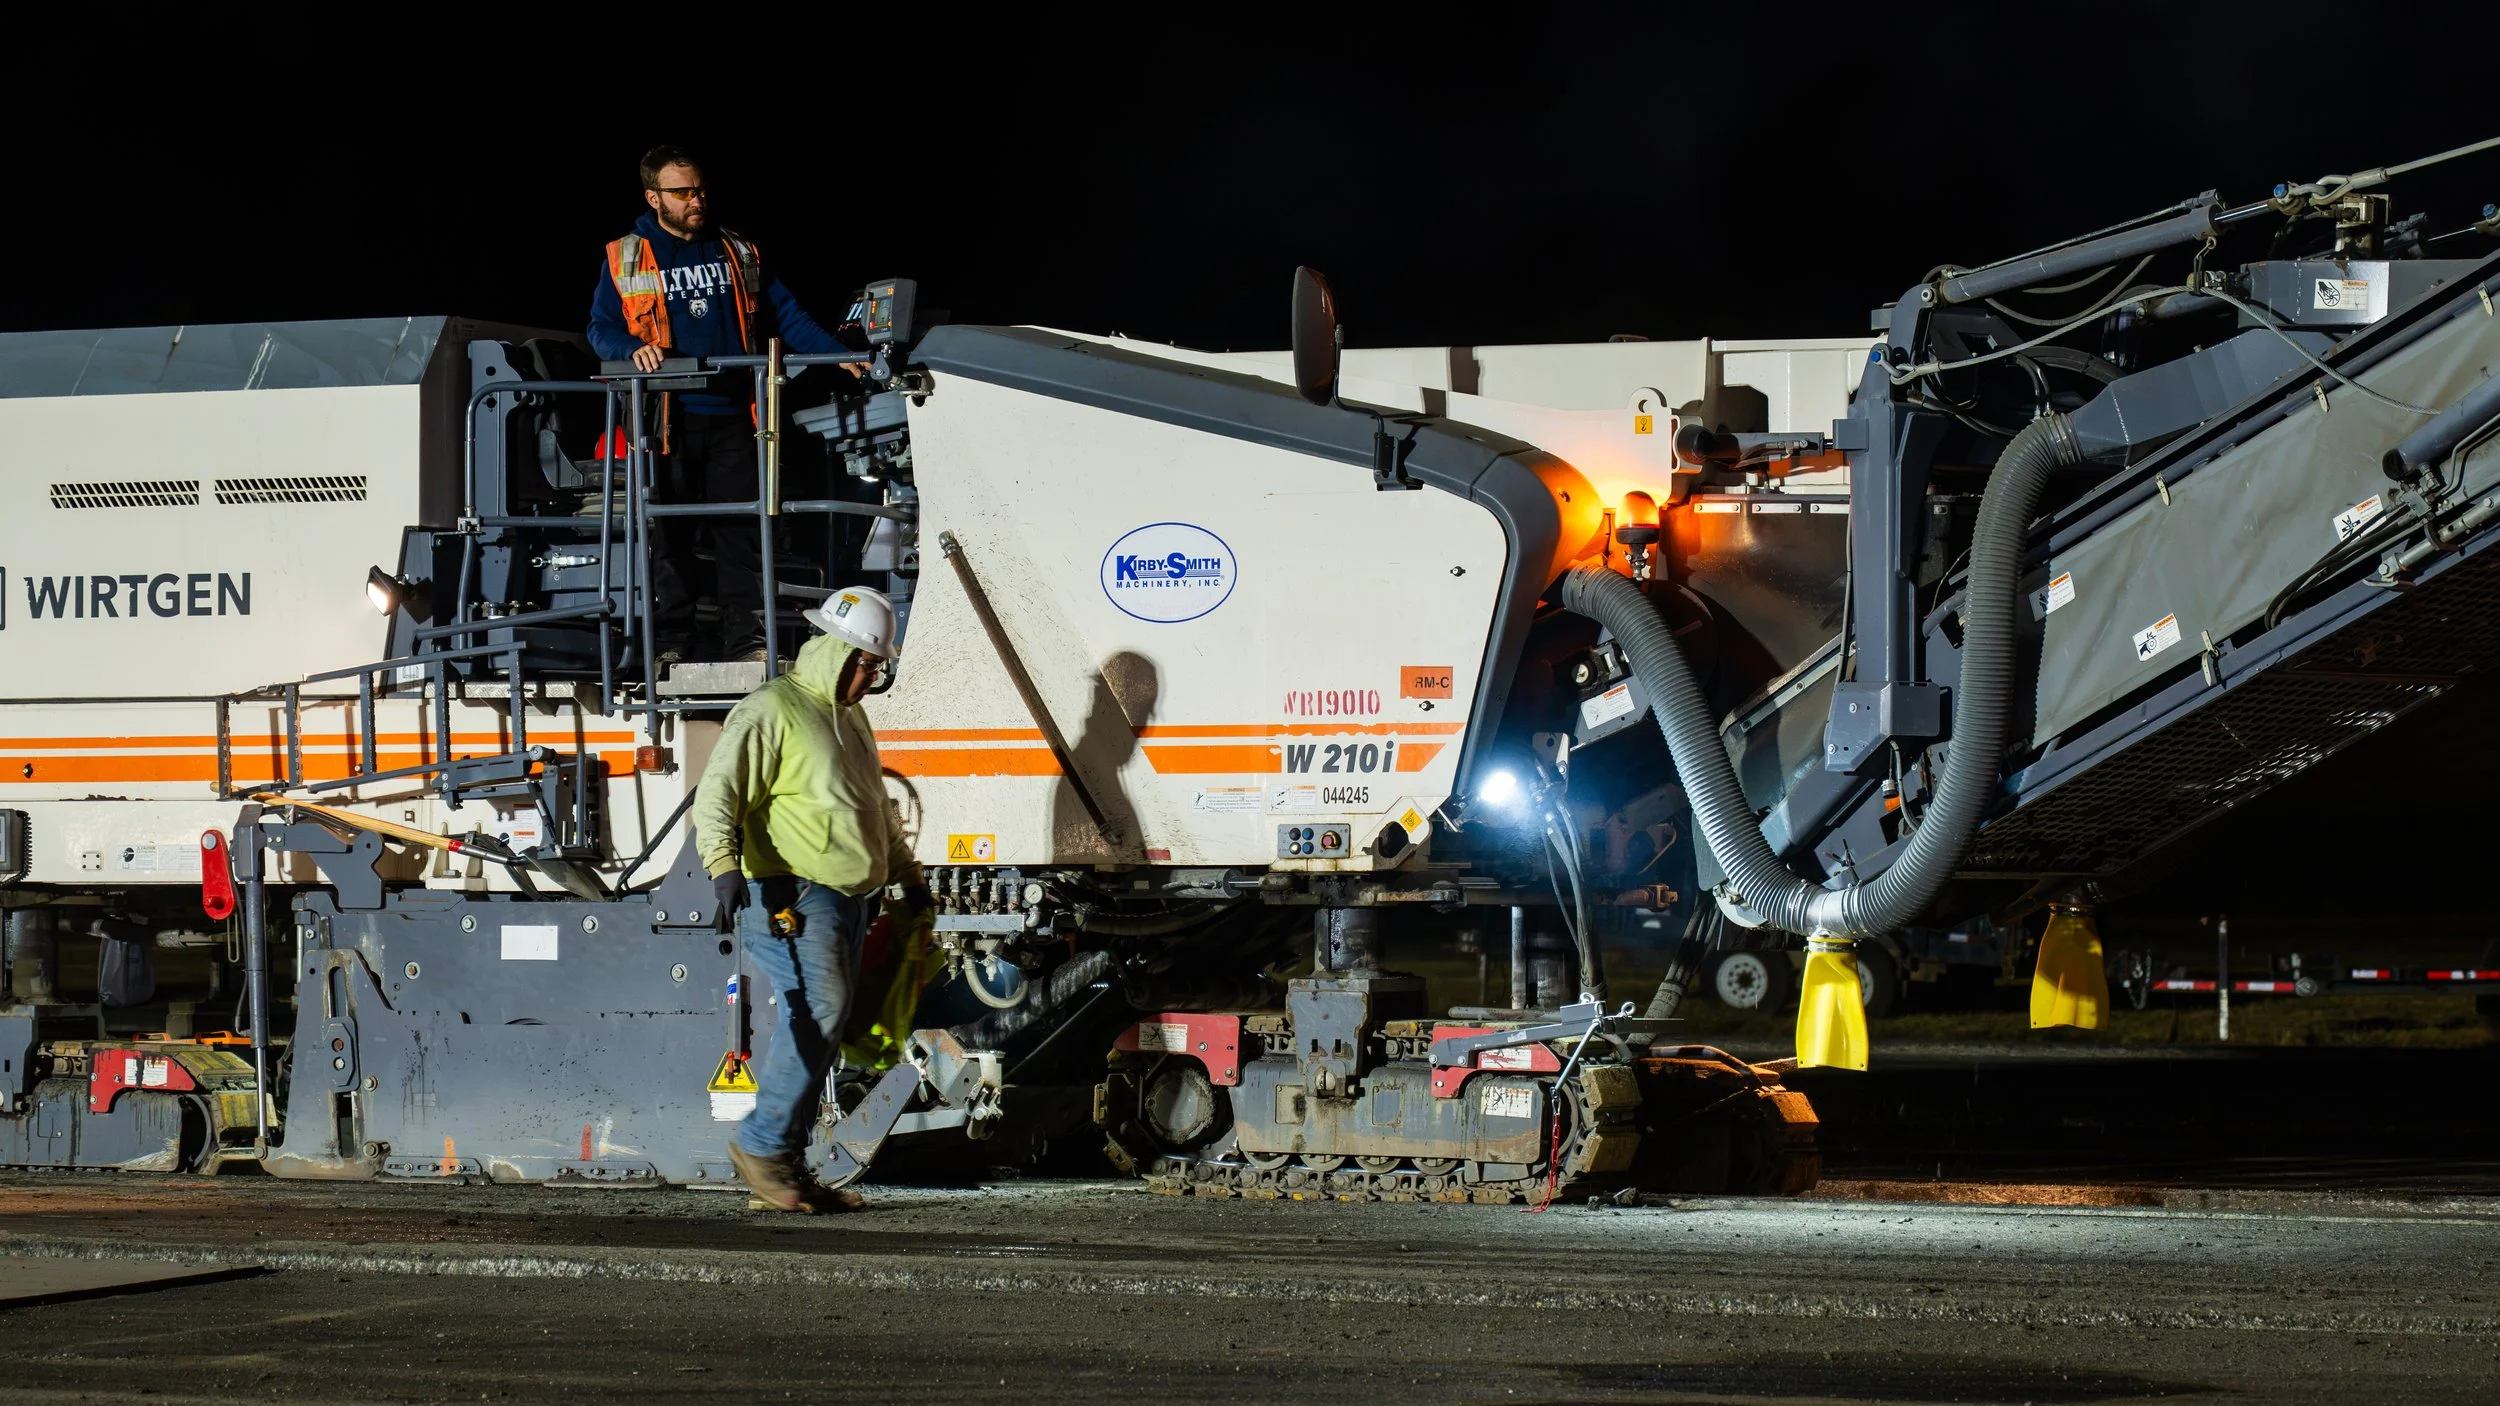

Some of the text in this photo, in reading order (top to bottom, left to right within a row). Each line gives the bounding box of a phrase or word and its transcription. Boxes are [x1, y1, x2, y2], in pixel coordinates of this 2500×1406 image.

[668, 286, 725, 300] BEARS
[1116, 552, 1220, 580] KIRBY-SMITH
[1116, 580, 1191, 588] MACHINERY,
[23, 572, 251, 619] WIRTGEN
[1287, 744, 1317, 773] W
[1323, 787, 1369, 804] 044245
